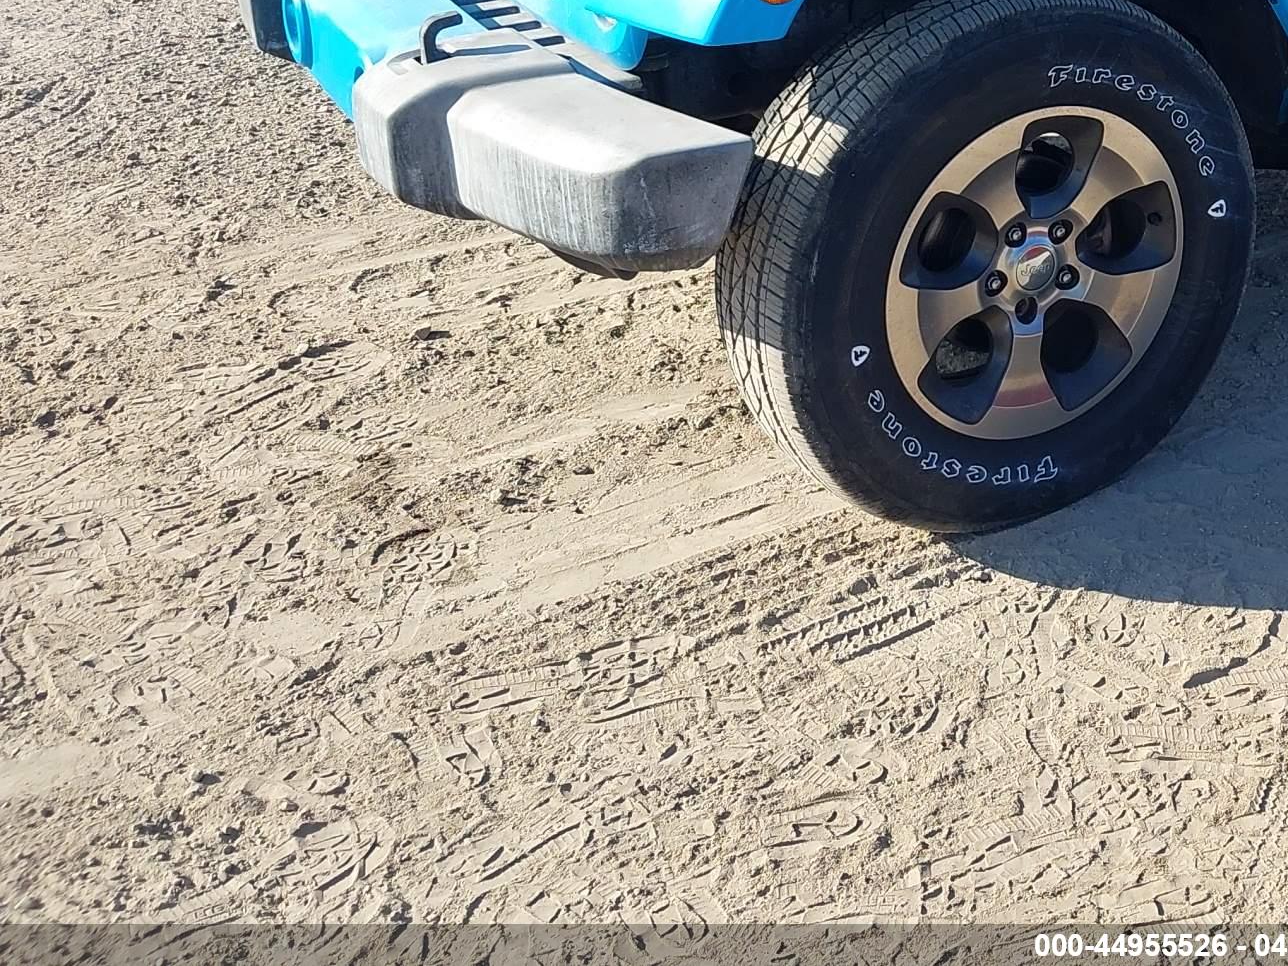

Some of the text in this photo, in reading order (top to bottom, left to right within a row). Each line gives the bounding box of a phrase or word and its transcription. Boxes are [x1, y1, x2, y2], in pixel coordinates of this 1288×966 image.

[1048, 64, 1215, 176] Firestone
[1020, 264, 1050, 276] Jeep
[867, 389, 1058, 485] Firestone
